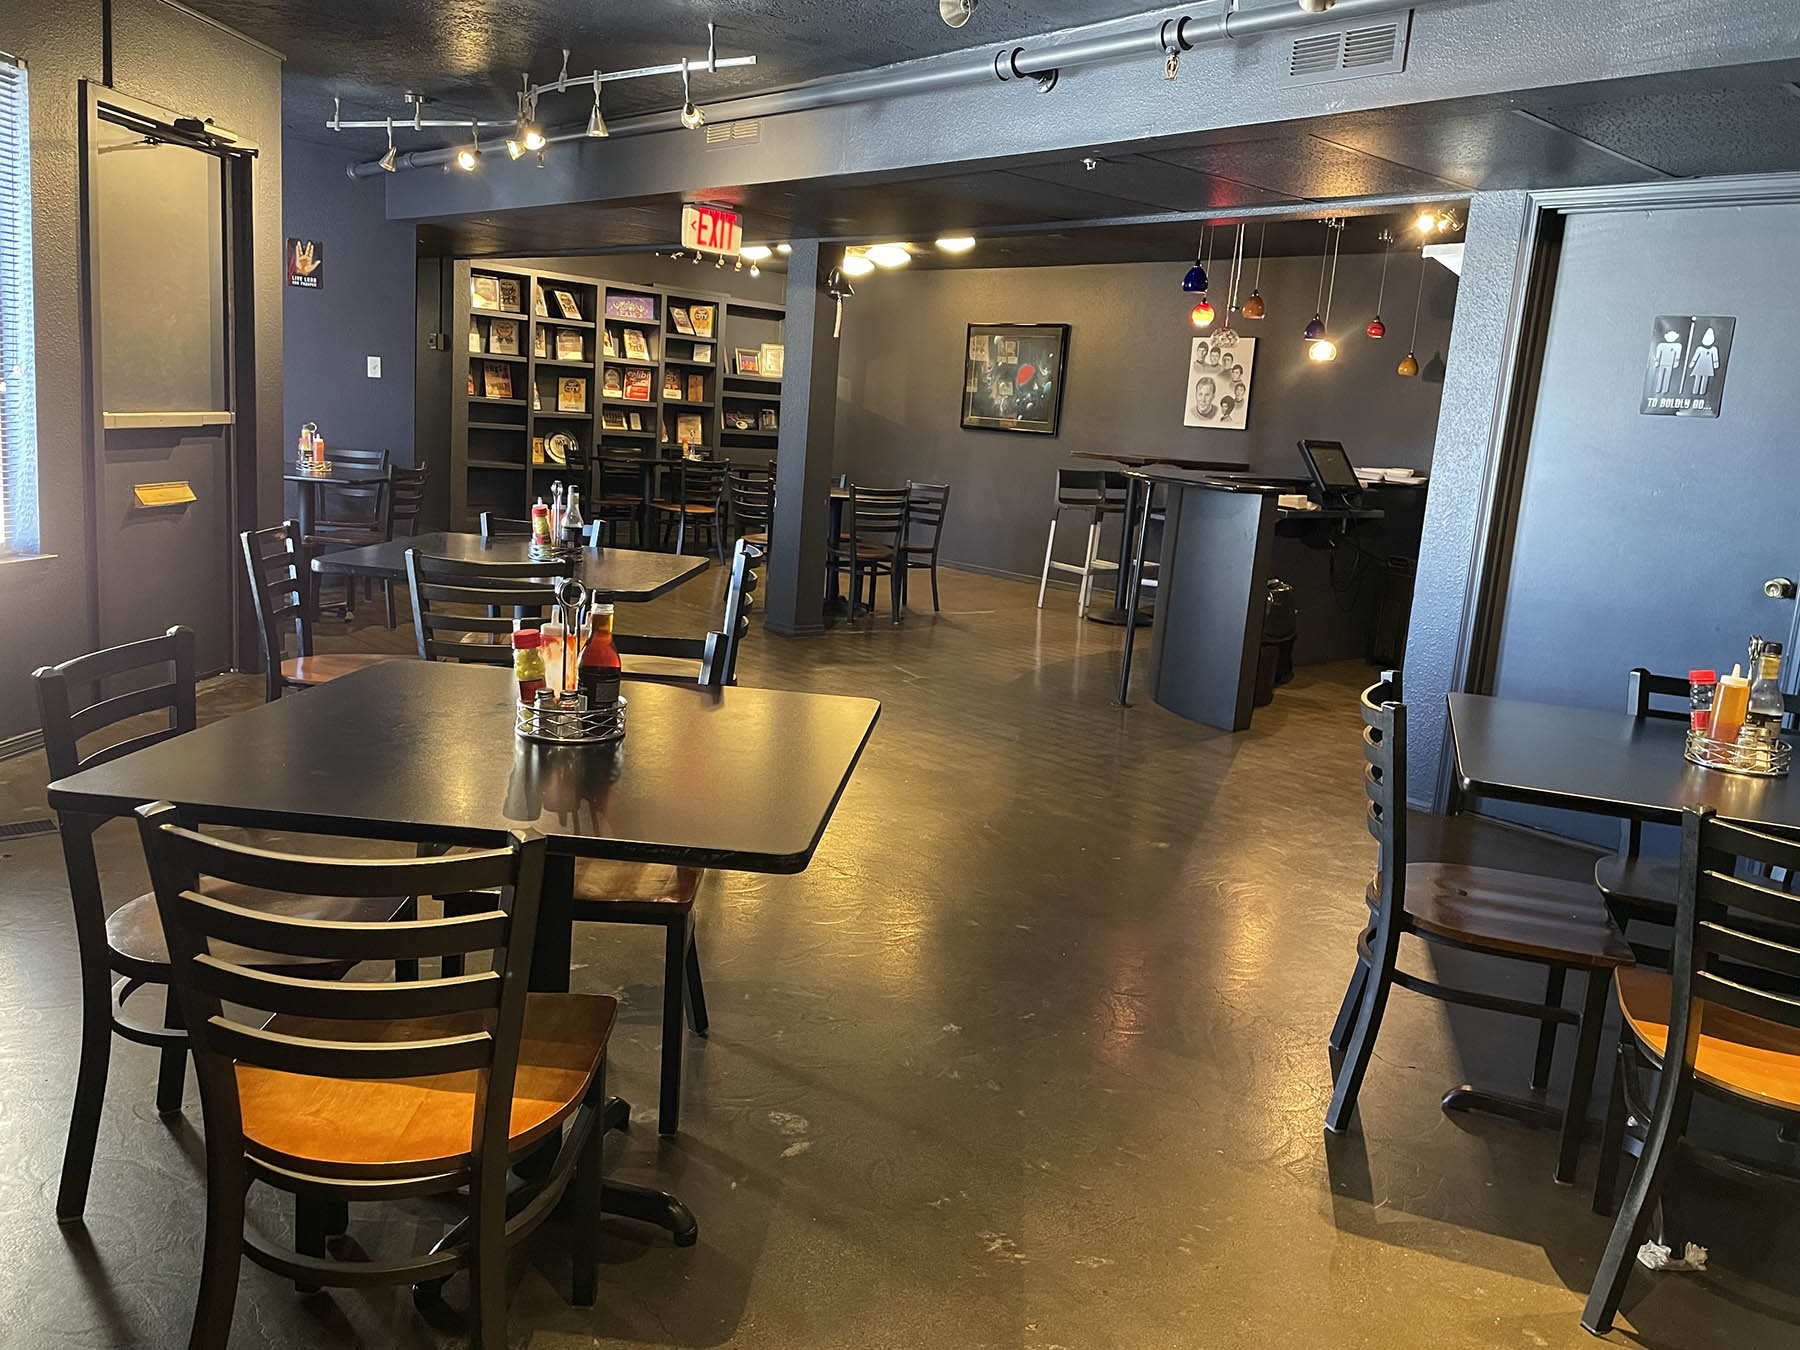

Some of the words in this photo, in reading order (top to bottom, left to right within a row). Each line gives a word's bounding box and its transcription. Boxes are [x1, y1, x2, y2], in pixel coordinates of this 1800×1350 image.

[697, 207, 737, 250] EXIT
[1648, 398, 1657, 408] TO
[1659, 398, 1691, 409] BOLDLY
